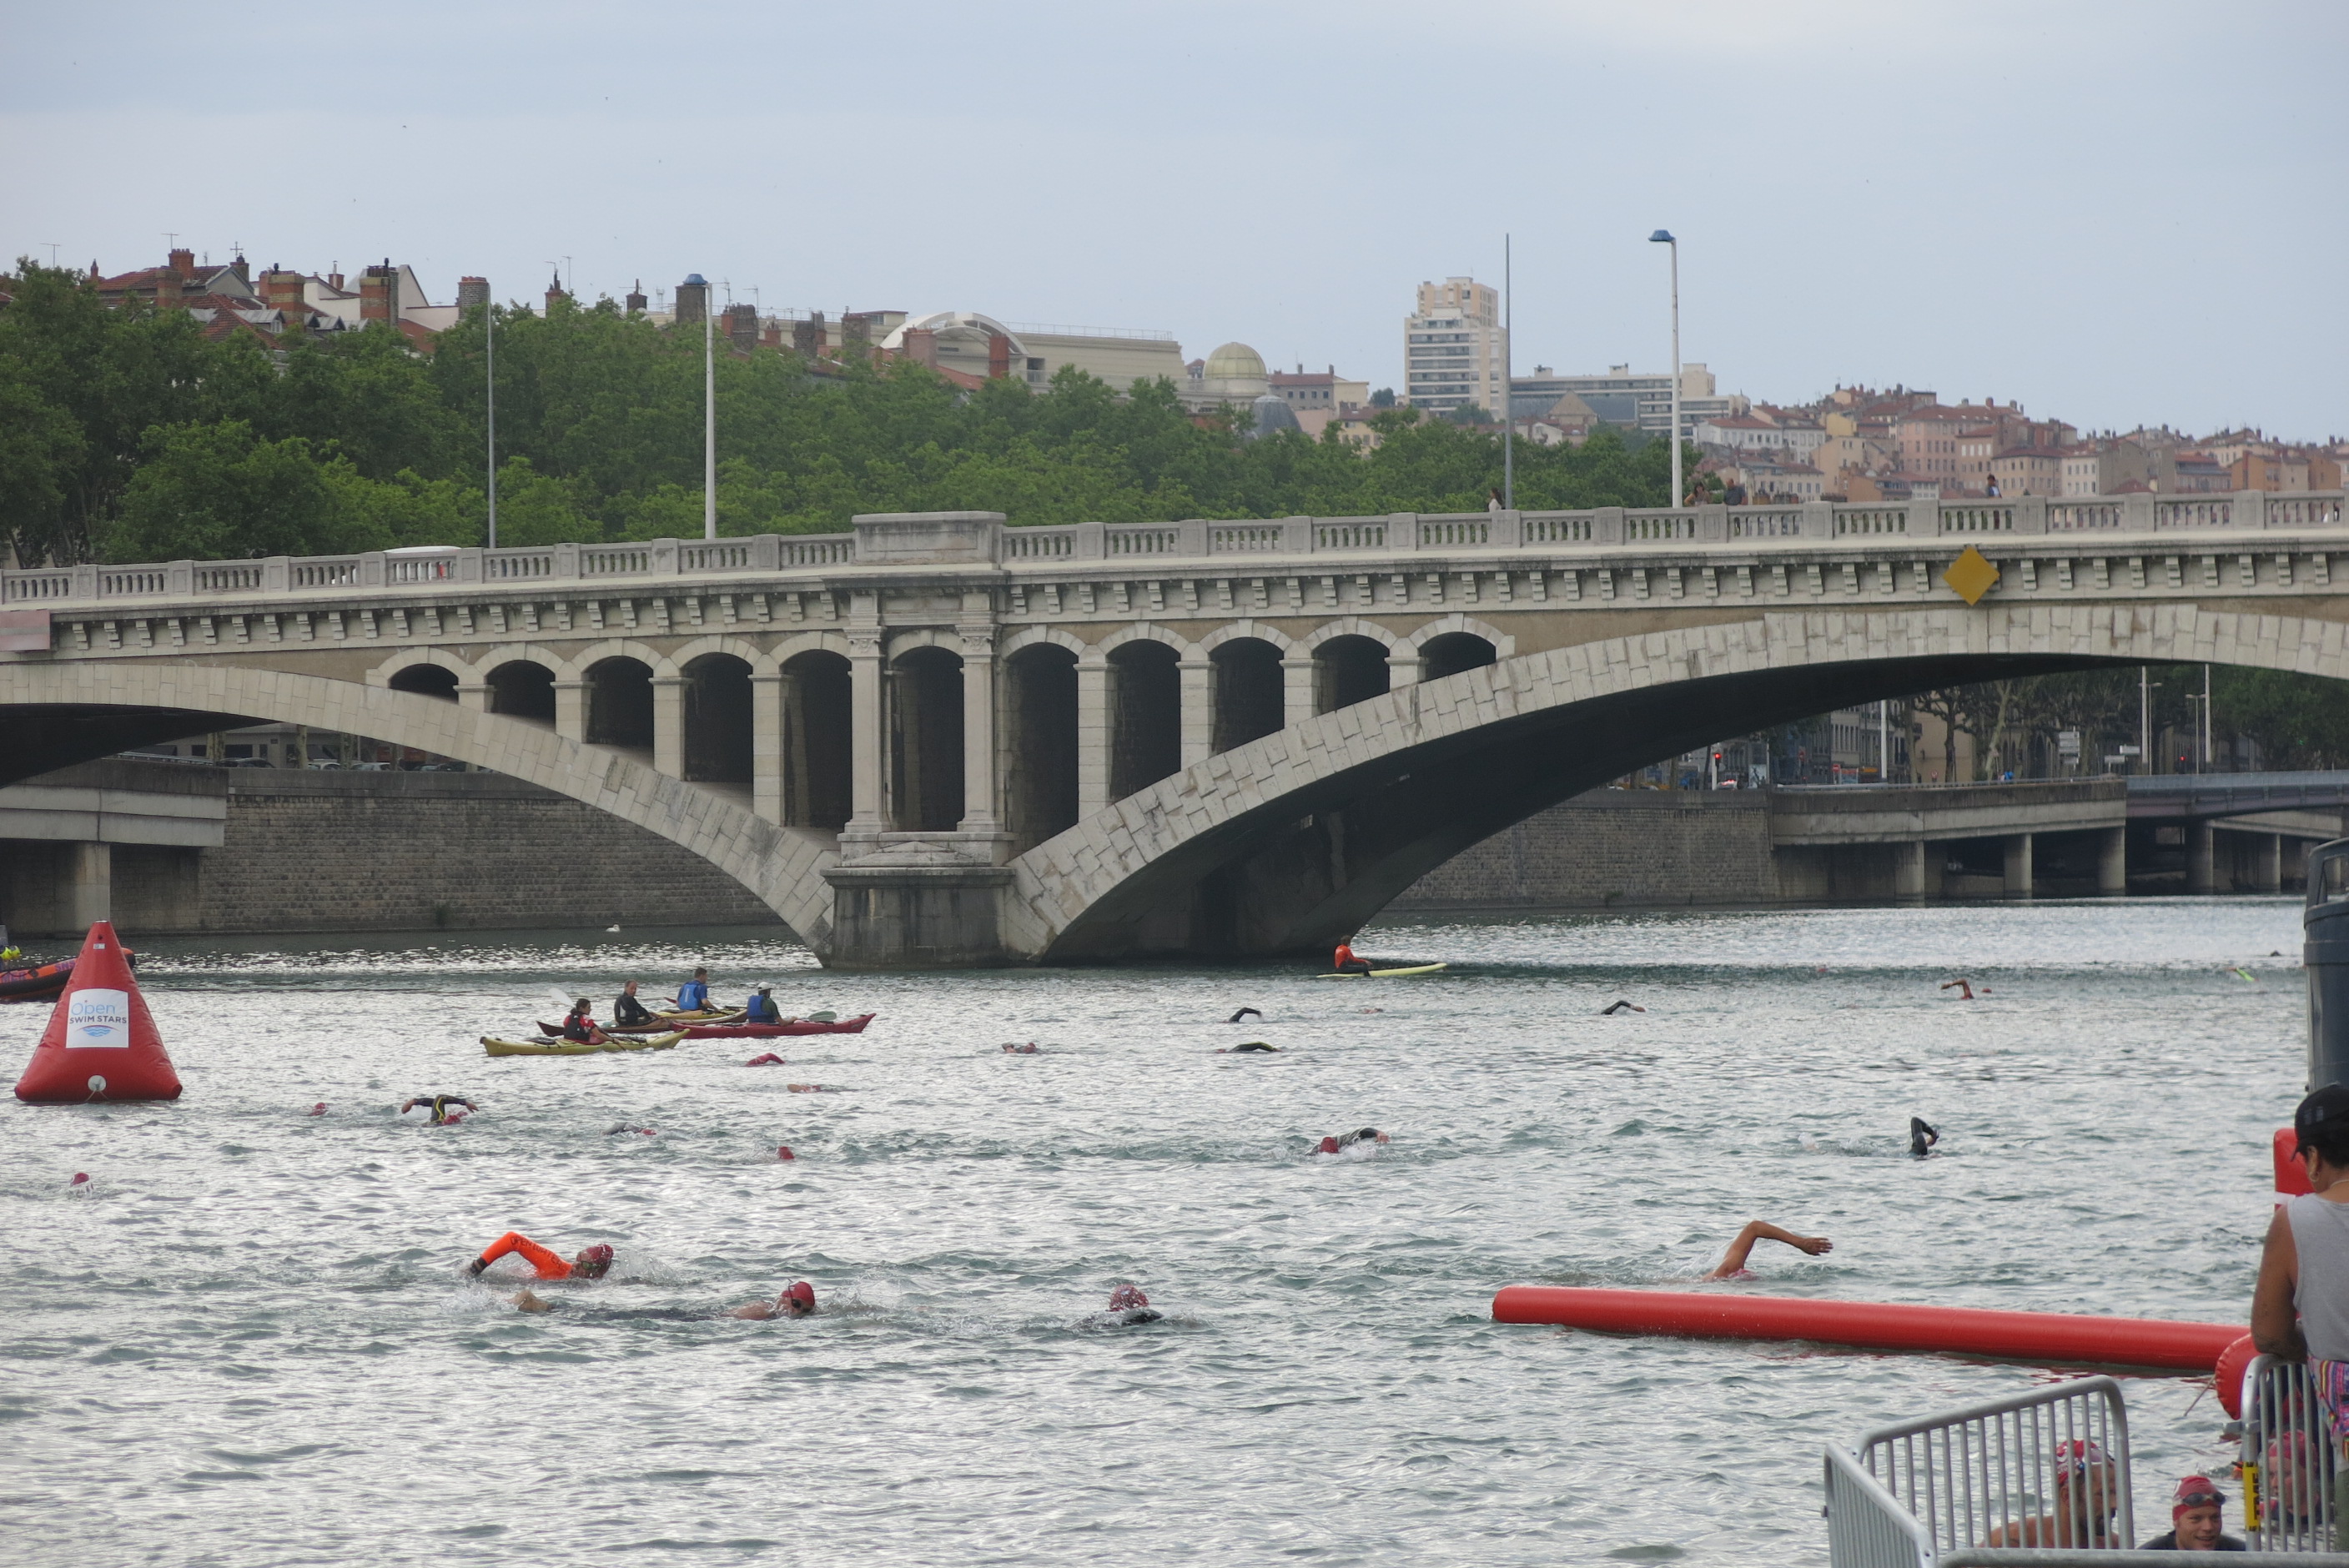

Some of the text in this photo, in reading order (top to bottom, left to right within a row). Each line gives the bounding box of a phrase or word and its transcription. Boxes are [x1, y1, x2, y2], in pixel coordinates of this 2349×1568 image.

[71, 1003, 116, 1016] Open
[69, 1015, 127, 1024] SWIM STARS
